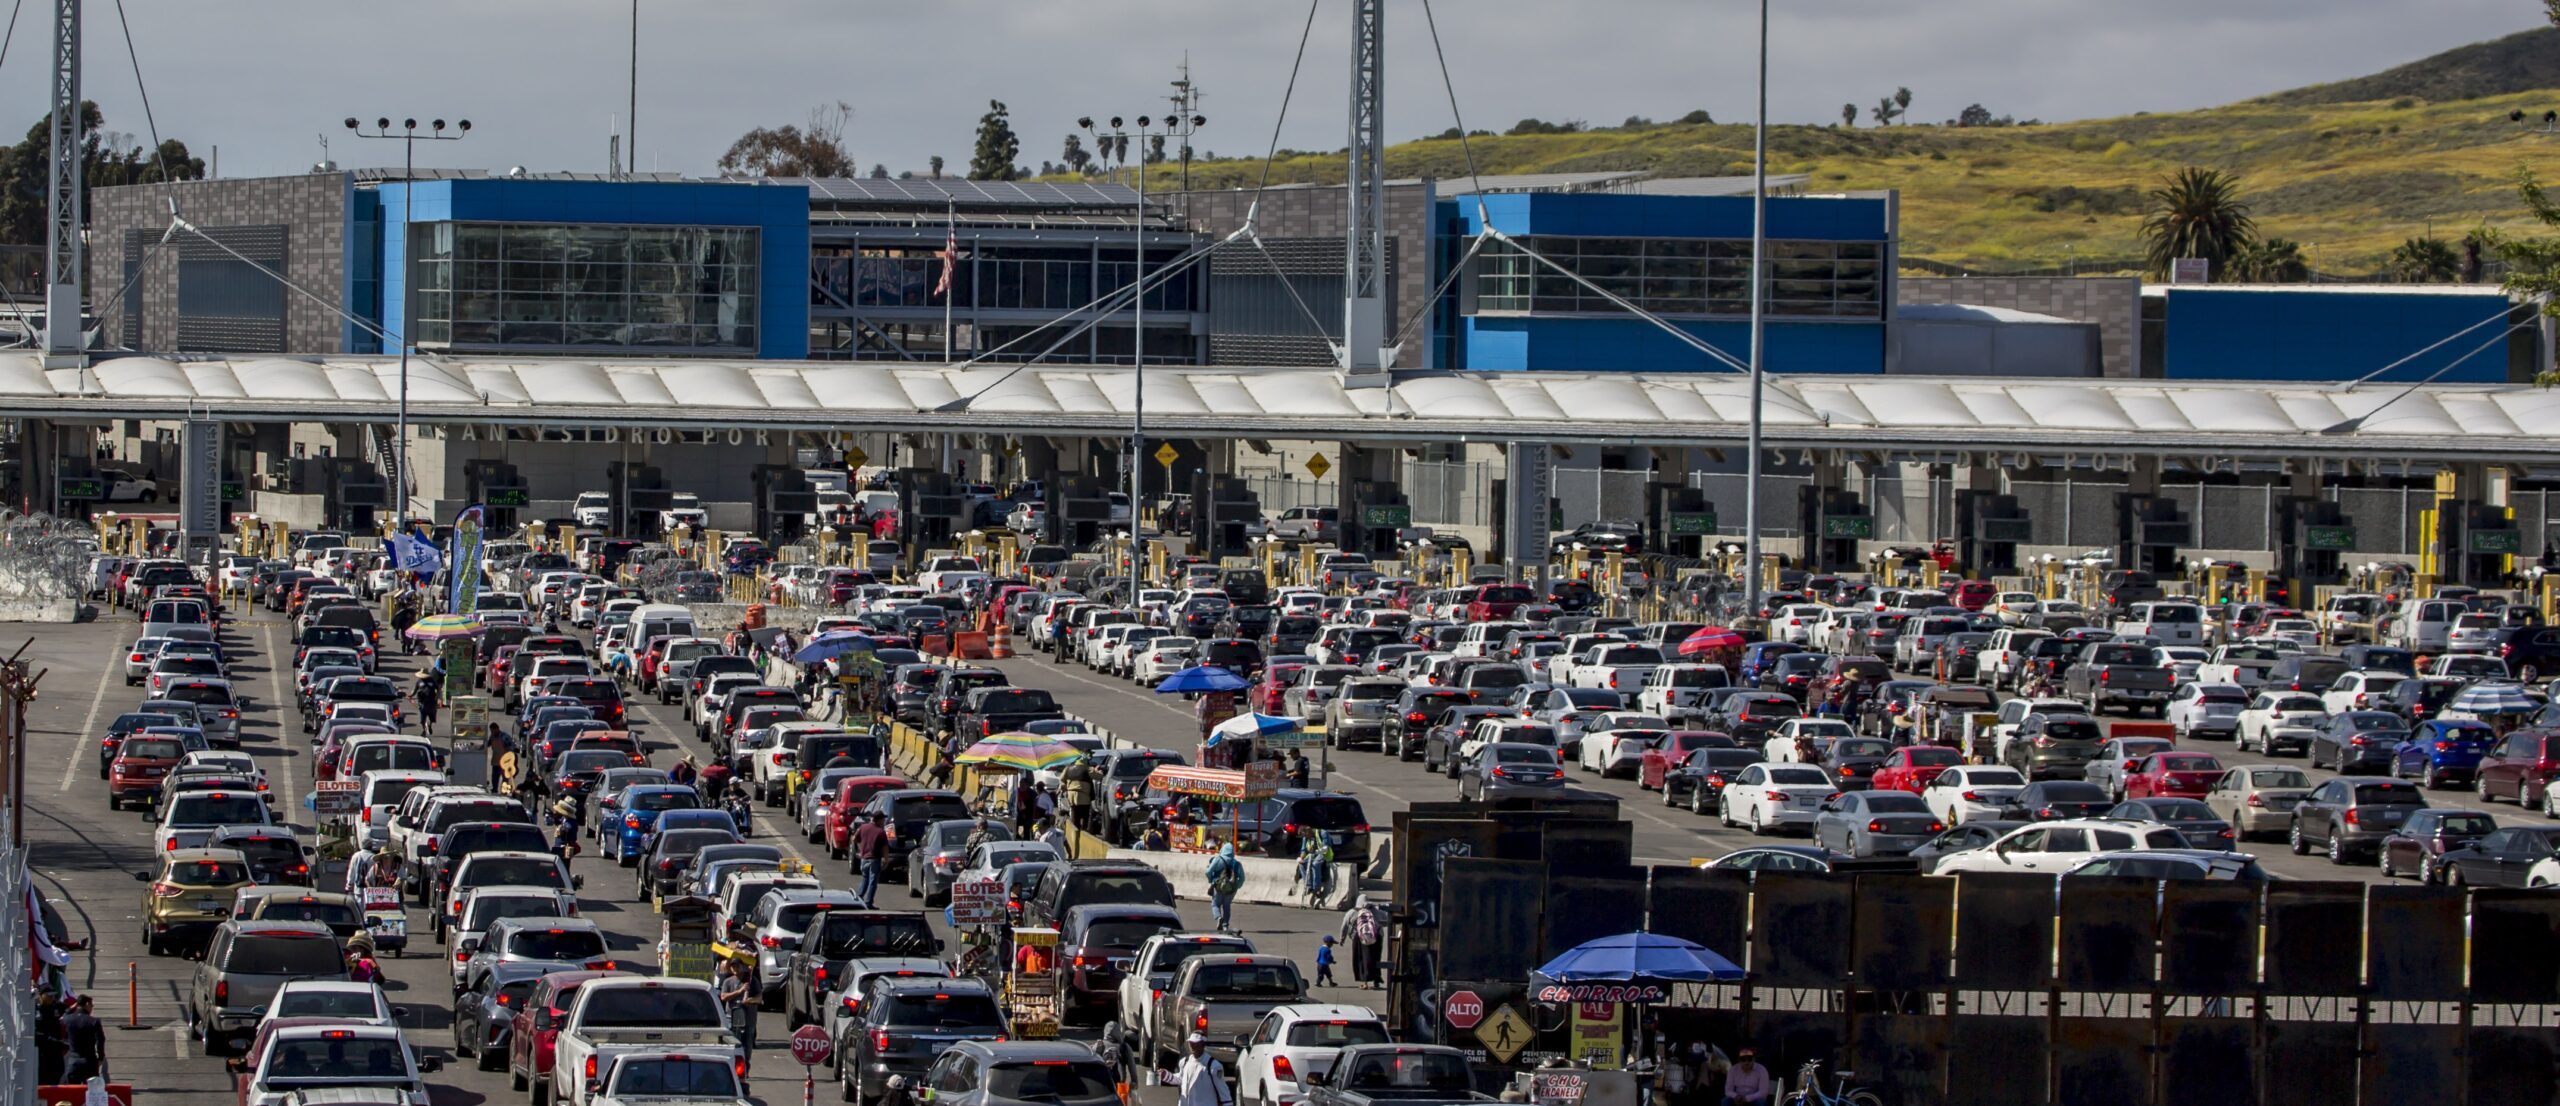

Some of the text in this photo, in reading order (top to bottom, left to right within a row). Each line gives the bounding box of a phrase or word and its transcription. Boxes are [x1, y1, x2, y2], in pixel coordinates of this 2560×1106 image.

[438, 424, 1016, 450] SAN YSIDRO PORT OF ENTRY
[1773, 448, 2412, 478] SAN YSIDRO PORT OF ENTRY
[204, 424, 216, 530] UNITED STATES
[1532, 446, 1546, 560] UNITED STATES
[318, 782, 360, 790] ELOTES
[1168, 776, 1187, 788] FRUTAS
[1194, 780, 1226, 792] TOSTILOCOS
[954, 882, 1004, 894] ELOTES
[1538, 985, 1658, 1002] CHURROS
[1448, 1004, 1481, 1016] ALTO
[794, 1037, 829, 1052] STOP
